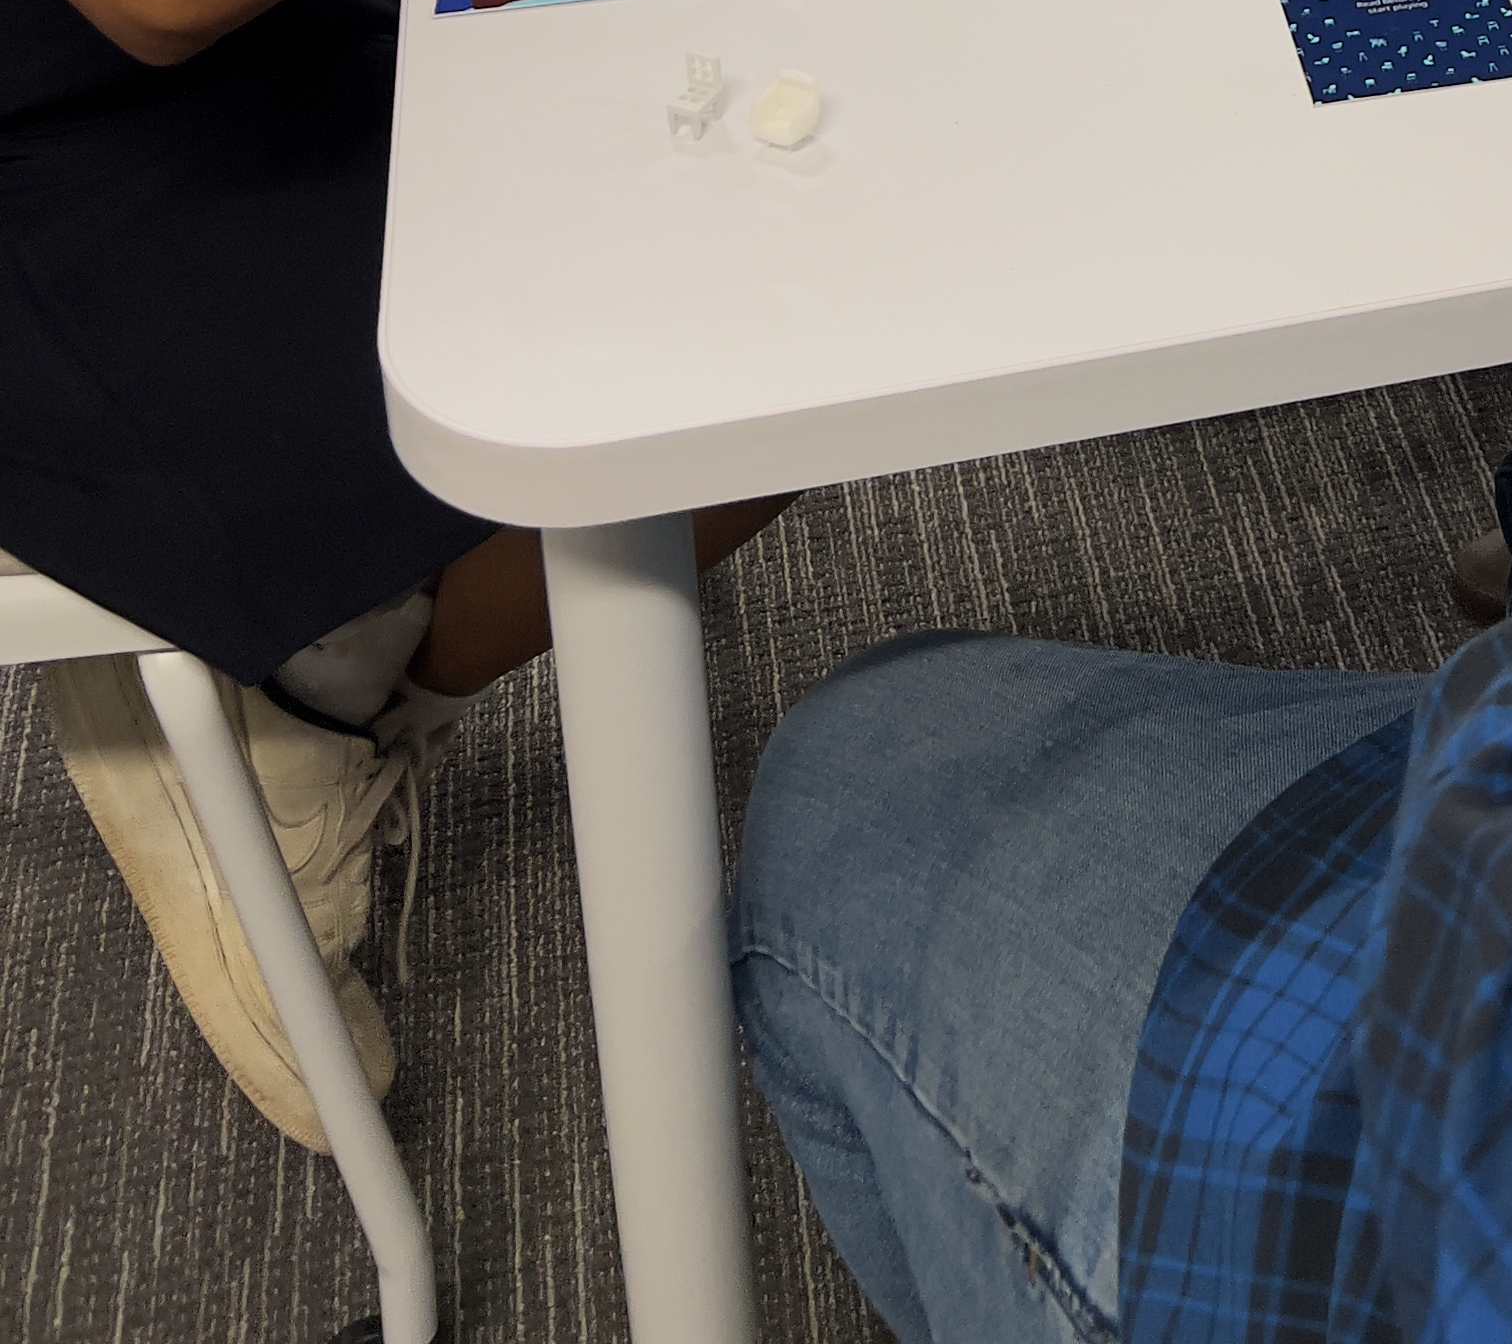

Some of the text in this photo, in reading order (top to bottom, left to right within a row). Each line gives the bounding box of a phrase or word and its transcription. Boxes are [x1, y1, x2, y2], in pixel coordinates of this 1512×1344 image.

[1356, 0, 1380, 8] Read
[1367, 0, 1429, 15] start playing
